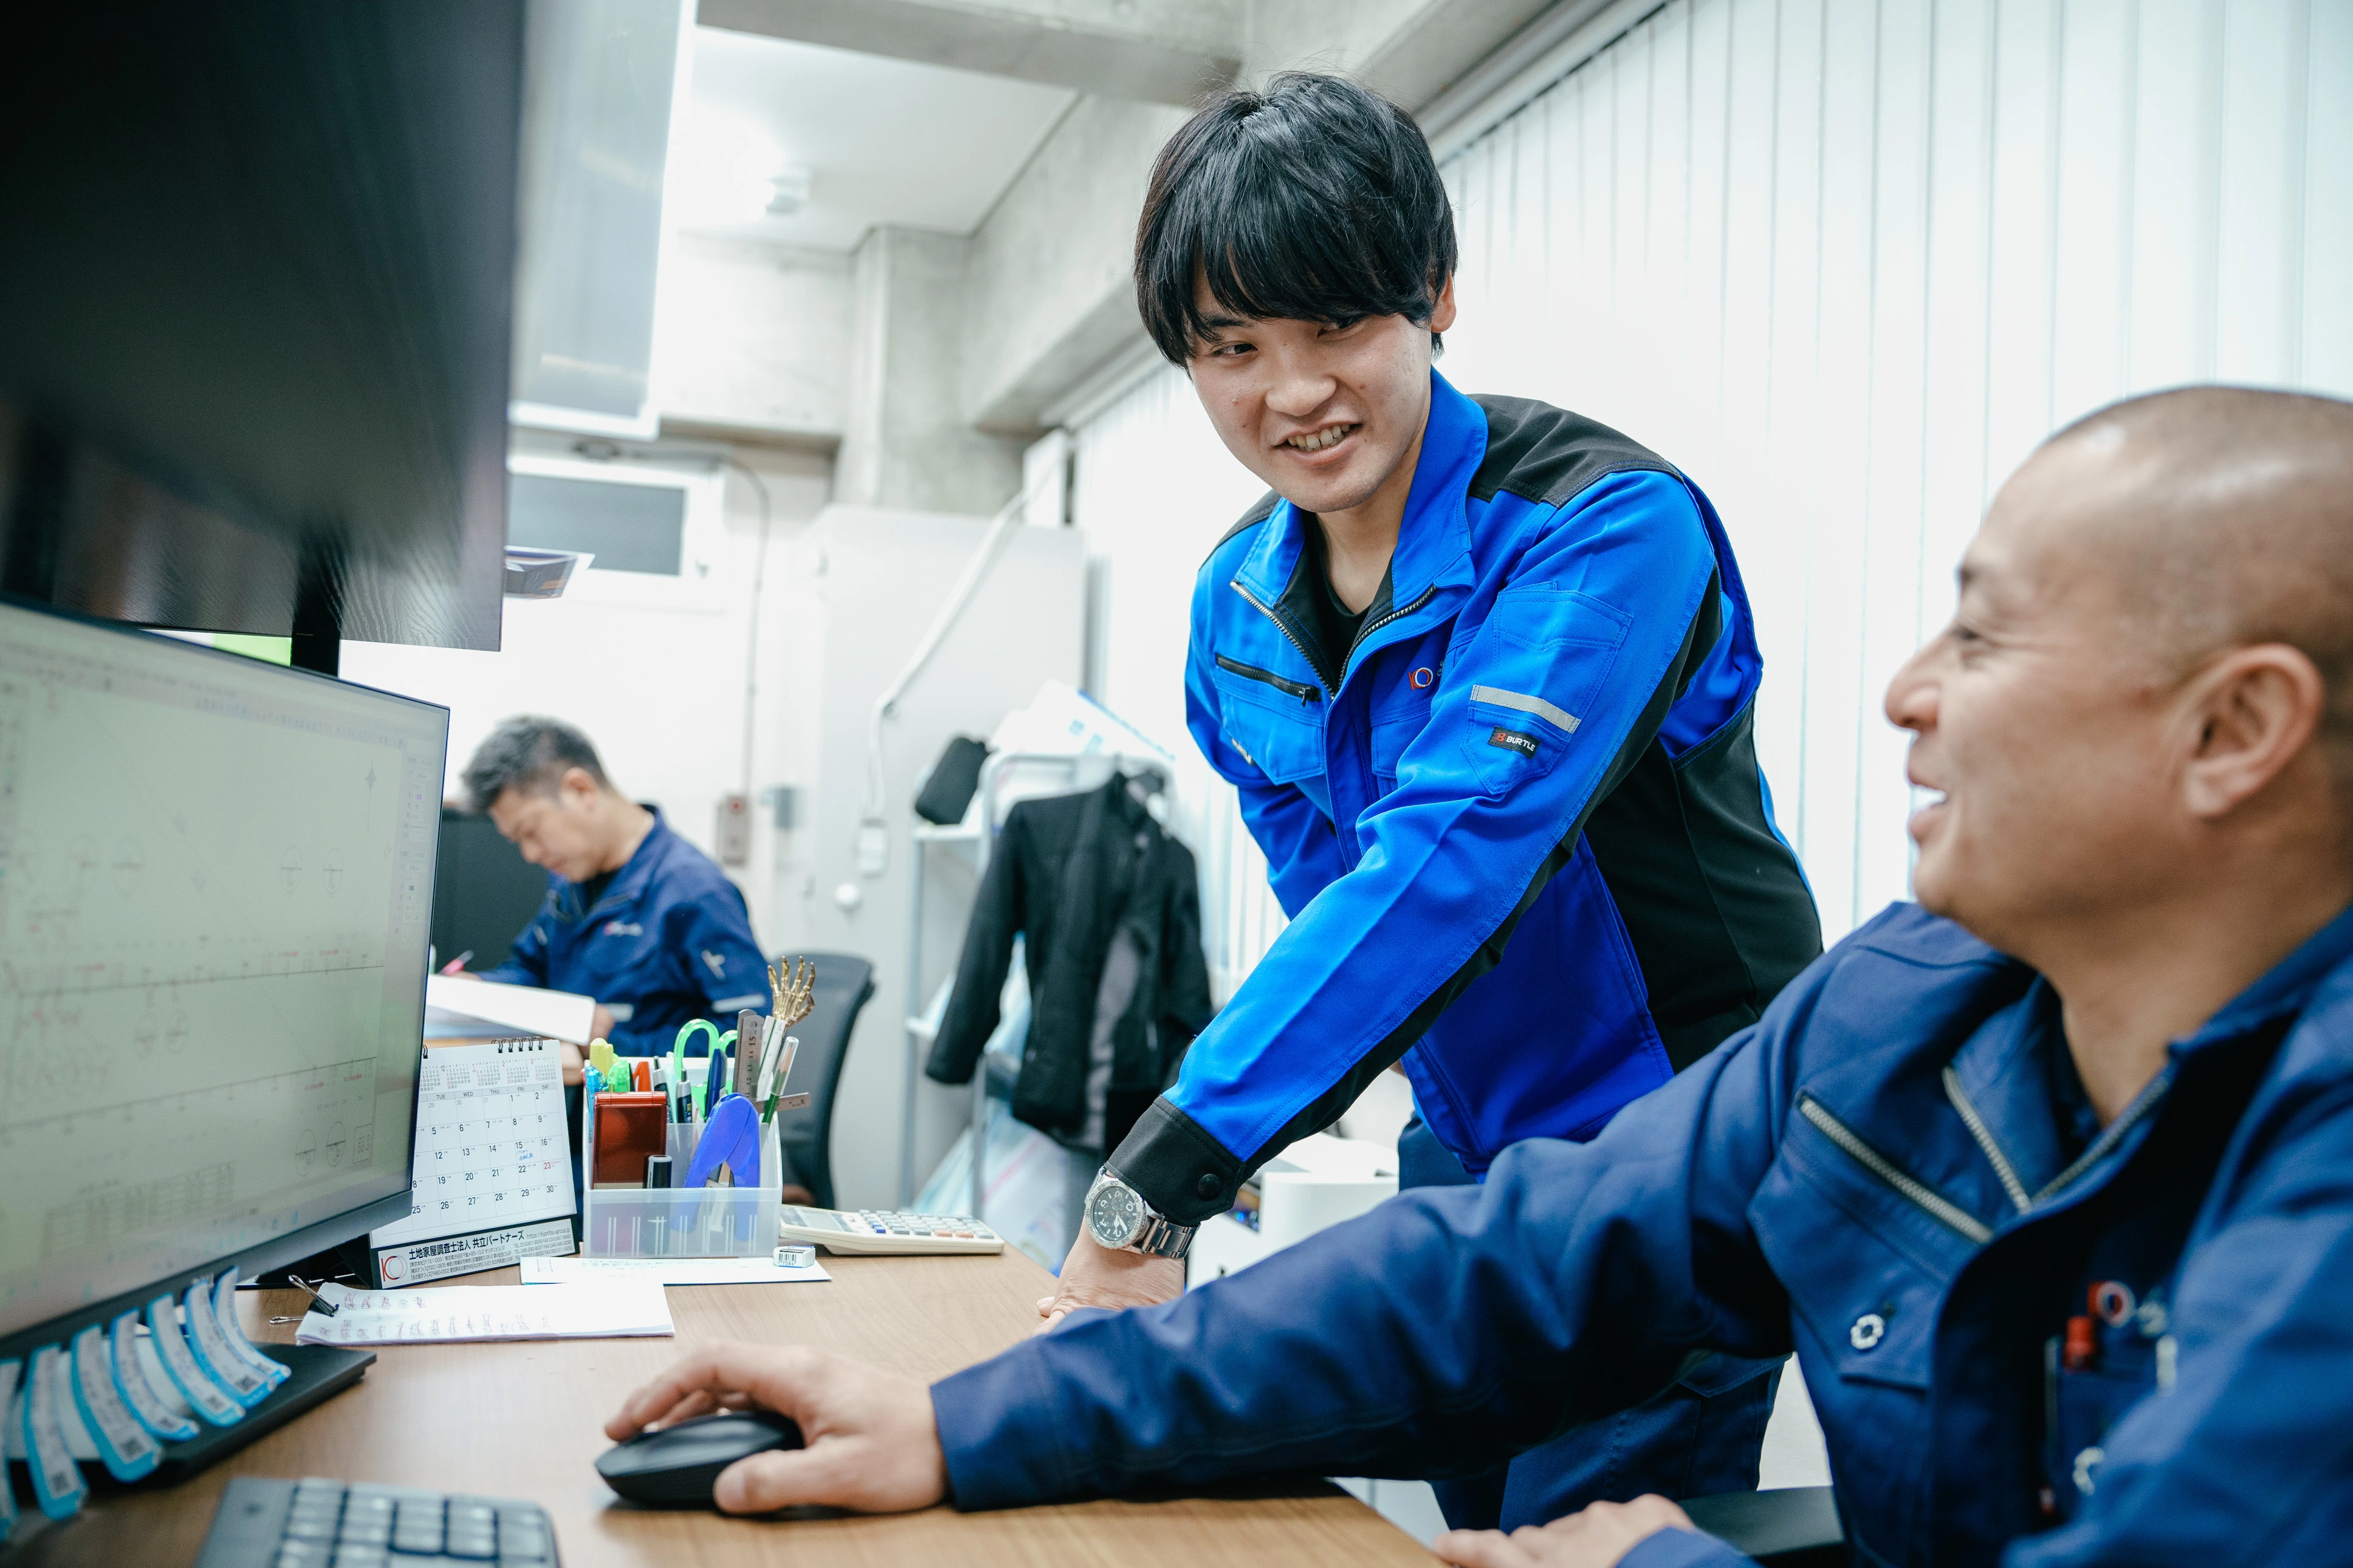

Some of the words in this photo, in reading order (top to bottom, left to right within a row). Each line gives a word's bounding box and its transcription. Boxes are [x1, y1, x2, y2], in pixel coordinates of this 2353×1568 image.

[1506, 736, 1536, 751] BURTLE
[749, 1036, 756, 1046] 15
[438, 1176, 446, 1185] 19
[465, 1173, 474, 1181] 20
[492, 1169, 500, 1177] 21
[412, 1206, 421, 1214] 25
[441, 1201, 449, 1210] 26
[468, 1197, 476, 1205] 27
[521, 1189, 529, 1197] 29
[1088, 1193, 1095, 1202] 30
[1126, 1200, 1135, 1211] 10
[1086, 1208, 1090, 1217] 35
[1099, 1218, 1107, 1227] 4
[1088, 1224, 1094, 1232] 40
[409, 1239, 471, 1260] 土地家屋調査士法人
[472, 1230, 524, 1249] 共立パートナーズ
[526, 1227, 571, 1239] https://kyoritsu-group.jp
